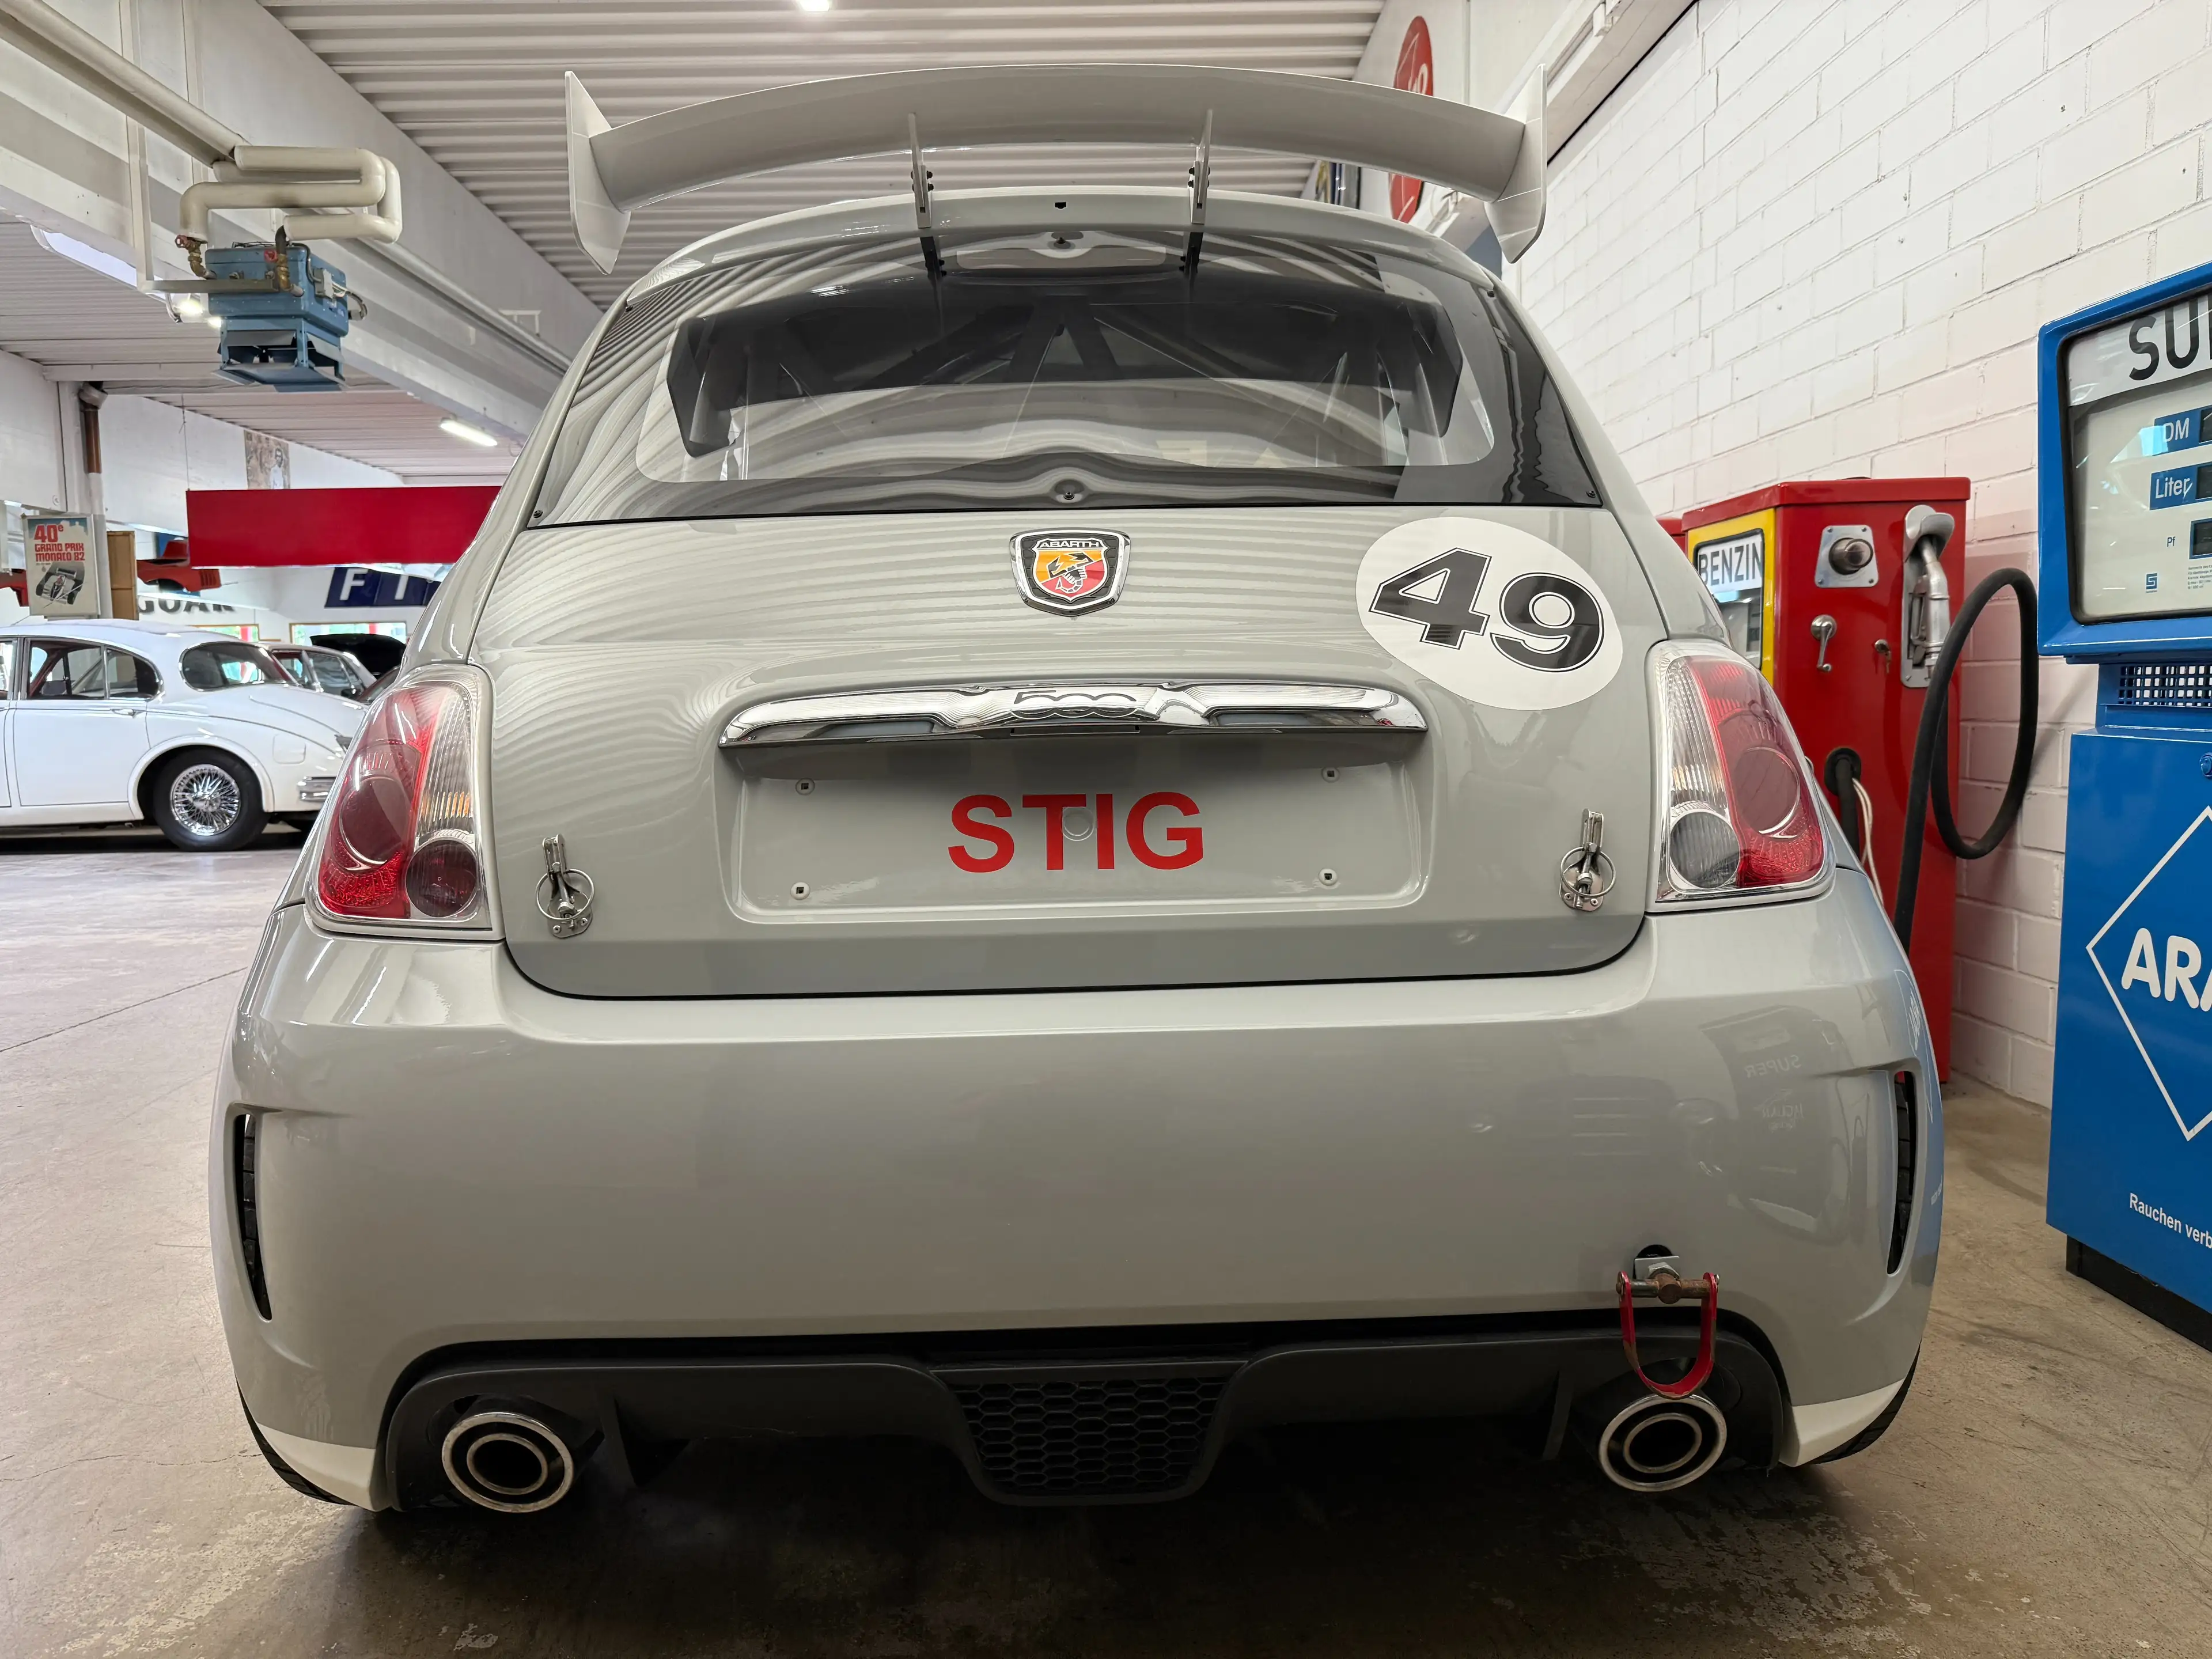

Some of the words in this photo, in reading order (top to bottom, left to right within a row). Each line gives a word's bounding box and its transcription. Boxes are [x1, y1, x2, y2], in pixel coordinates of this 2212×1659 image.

[2128, 295, 2212, 381] SU
[2163, 418, 2190, 442] DM
[2155, 477, 2191, 499] Liter
[35, 543, 63, 552] GRAND
[65, 543, 84, 551] PRIX
[35, 552, 72, 562] MONACO
[74, 552, 85, 561] 82
[2166, 536, 2176, 547] Pf
[1699, 542, 1763, 586] BENZIN
[1368, 547, 1605, 673] 49
[948, 791, 1204, 873] STIG
[2121, 927, 2212, 1012] AR
[2130, 1192, 2181, 1233] Rauchen
[2185, 1224, 2212, 1249] verb
